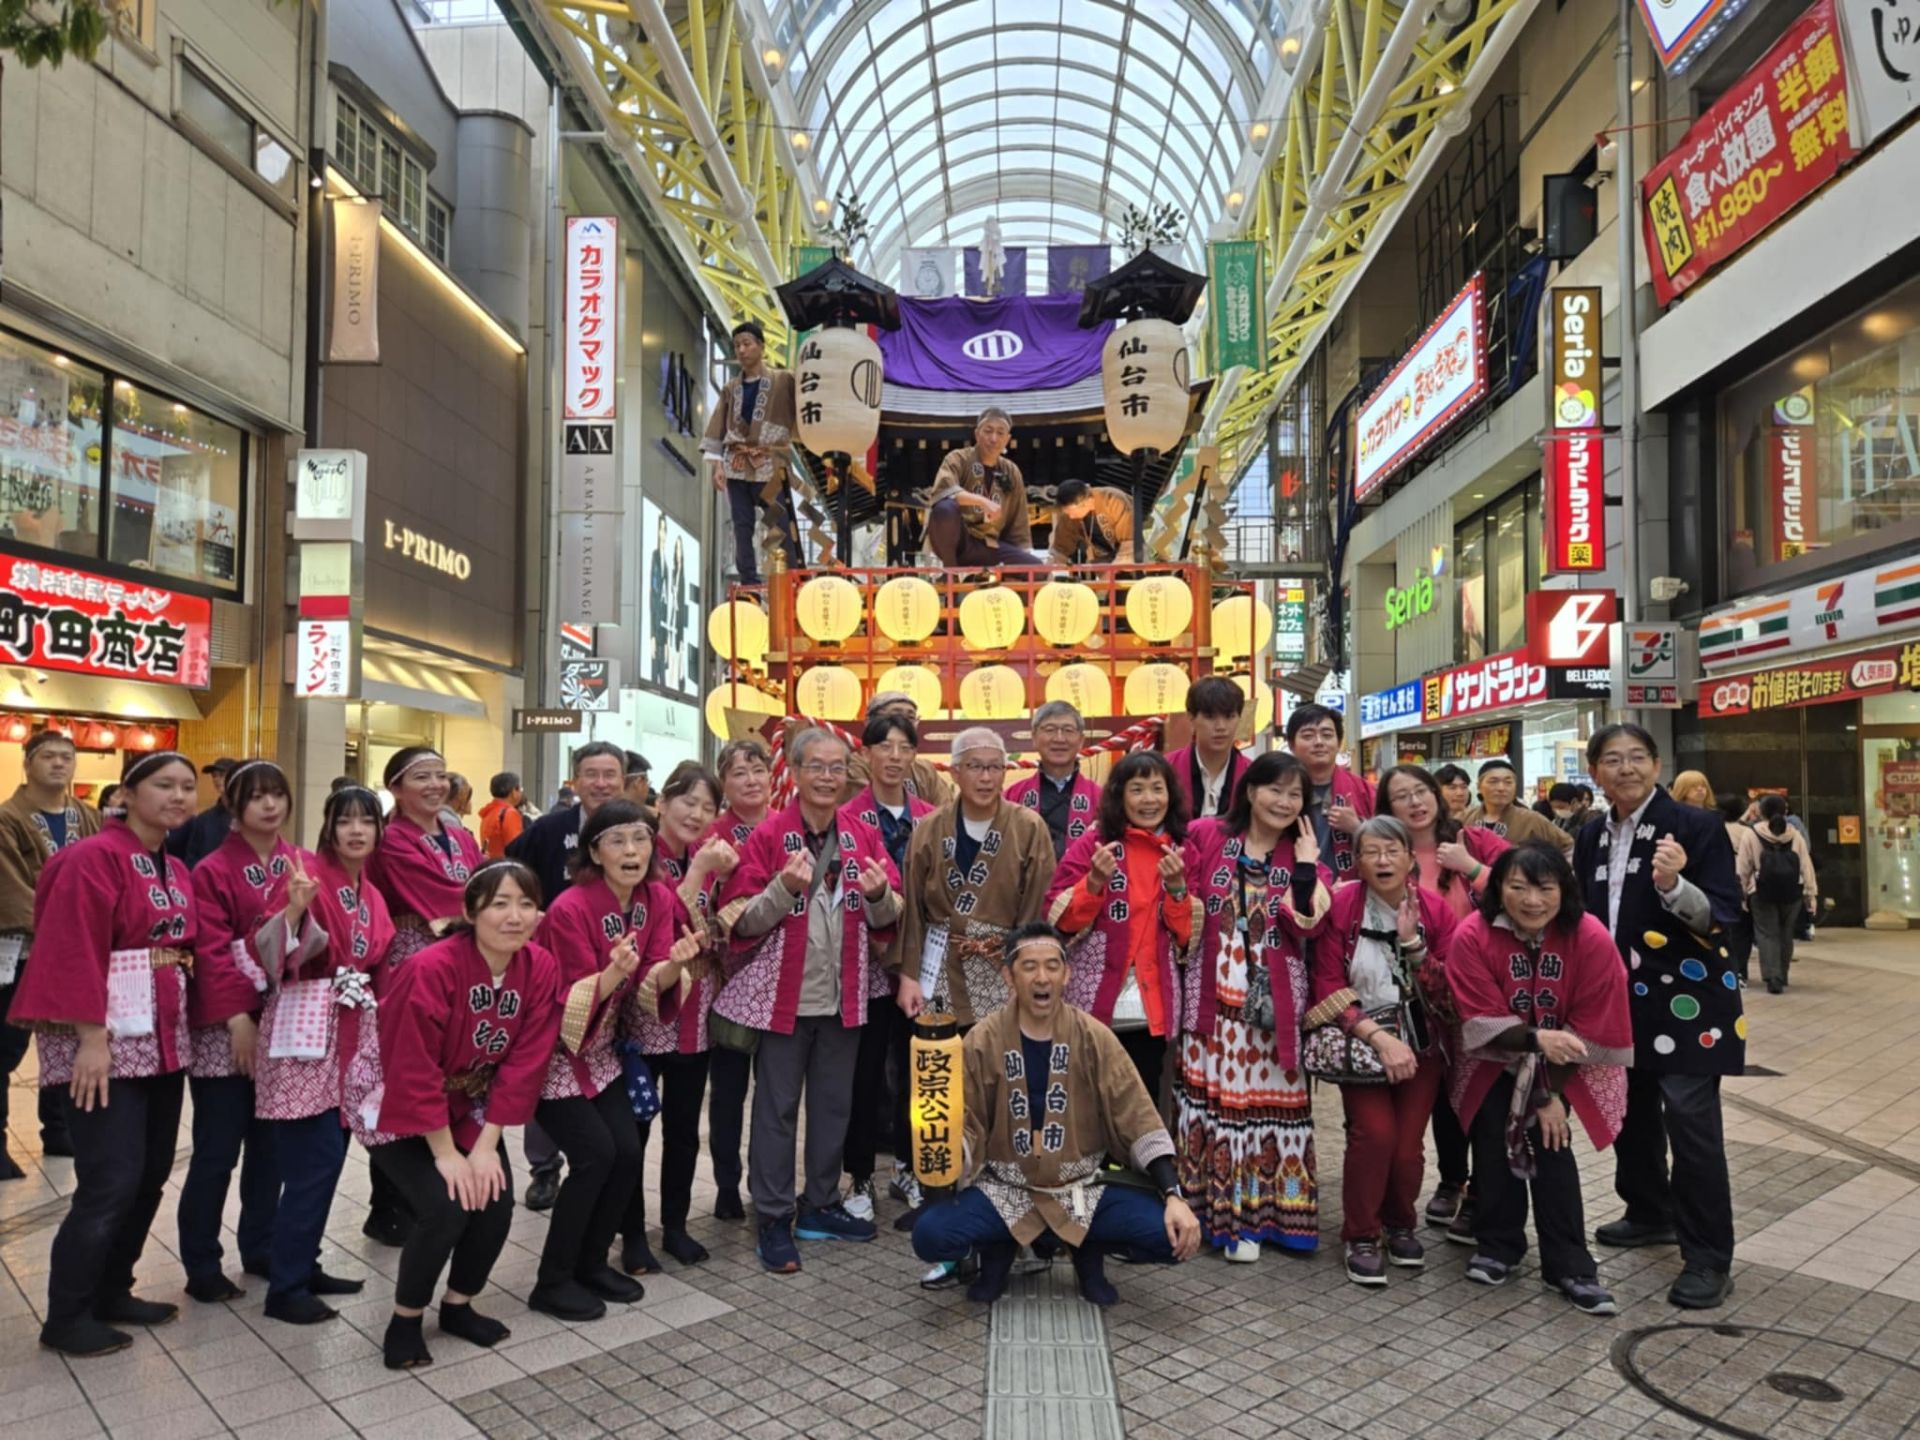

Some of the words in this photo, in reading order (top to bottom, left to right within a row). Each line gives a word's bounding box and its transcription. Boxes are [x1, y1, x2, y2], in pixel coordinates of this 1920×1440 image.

[1777, 32, 1840, 113] 半額
[1680, 82, 1764, 179] オーダーバイキング
[1684, 104, 1777, 219] 食べ放題
[1789, 90, 1849, 173] 無料
[1654, 188, 1687, 267] 焼肉
[579, 243, 602, 410] カラオケマック
[1563, 295, 1593, 379] Seria
[800, 341, 822, 425] 仙台市
[1118, 337, 1151, 418] 仙台市
[1367, 394, 1402, 457] カラオケ
[1413, 327, 1469, 422] まねきねこ
[568, 425, 612, 453] AX
[584, 466, 594, 529] ARMANI
[1569, 432, 1590, 543] サンドラッグ
[384, 519, 472, 581] I-PRIMO
[583, 536, 595, 617] EXCHANGE
[0, 592, 186, 678] 町田商店
[1278, 604, 1303, 618] ネット
[1278, 618, 1303, 632] カフェ
[1385, 567, 1434, 631] Seria
[306, 624, 328, 694] ラーメン
[562, 662, 604, 678] ダーツ
[1456, 657, 1547, 713] サンドラッグ
[1752, 668, 1847, 709] お値段そのまま!
[526, 715, 573, 727] I-PRIMO
[1399, 741, 1427, 751] Seria
[841, 832, 866, 914] 仙台市
[954, 830, 1001, 916] 仙台市
[1206, 838, 1242, 917] 仙台市
[469, 985, 494, 1049] 仙台
[494, 989, 519, 1055] 仙台
[1510, 952, 1533, 1014] 仙台
[915, 1048, 952, 1178] 政宗公山鉾
[1003, 1049, 1032, 1159] 仙台市
[1042, 1043, 1070, 1153] 仙台市
